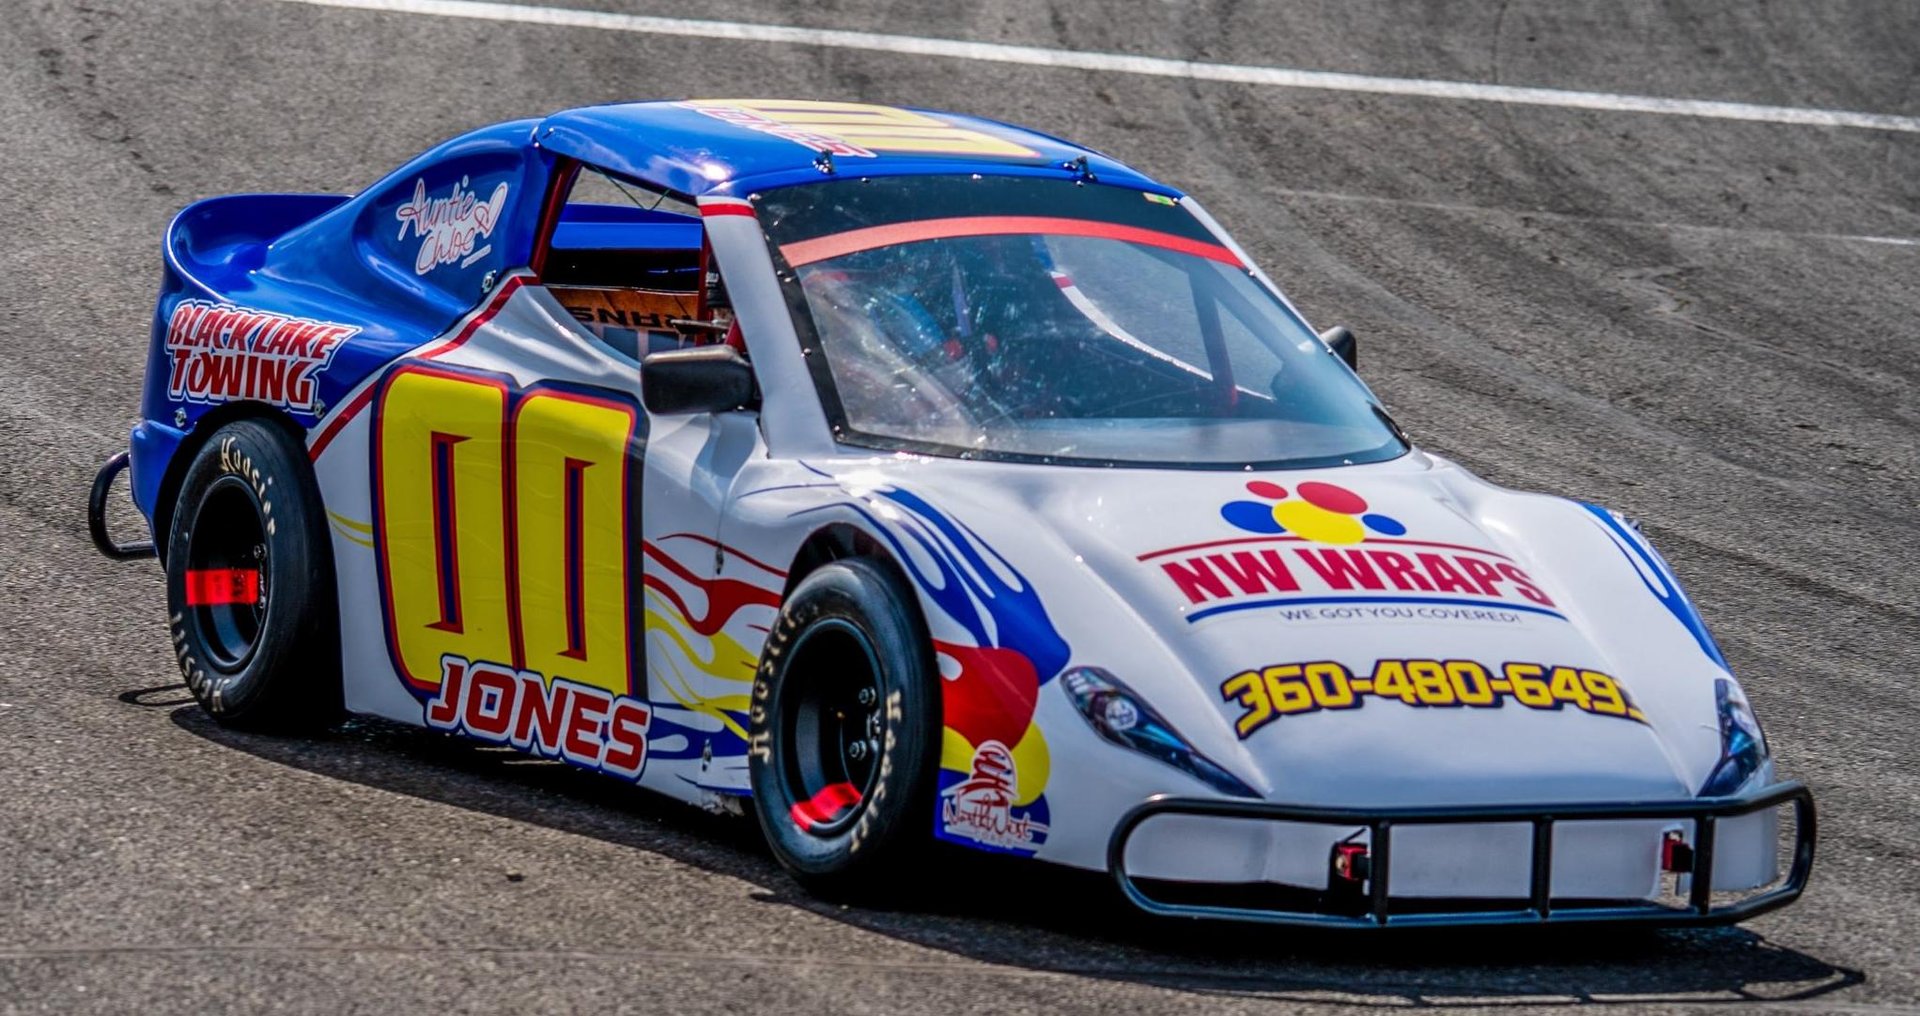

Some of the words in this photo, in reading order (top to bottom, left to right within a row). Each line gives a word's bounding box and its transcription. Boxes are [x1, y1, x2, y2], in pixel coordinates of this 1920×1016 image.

[396, 175, 478, 241] Auntie
[168, 302, 263, 352] BLACK
[253, 312, 350, 360] LAKE
[171, 348, 314, 405] TOWING
[370, 359, 650, 706] 00
[1160, 549, 1301, 604] NW
[1293, 547, 1558, 608] WRAPS
[1279, 609, 1318, 621] WE
[1319, 607, 1363, 619] GOT
[1362, 606, 1413, 619] YOU
[1417, 607, 1522, 624] COVERED!
[428, 658, 650, 778] JONES
